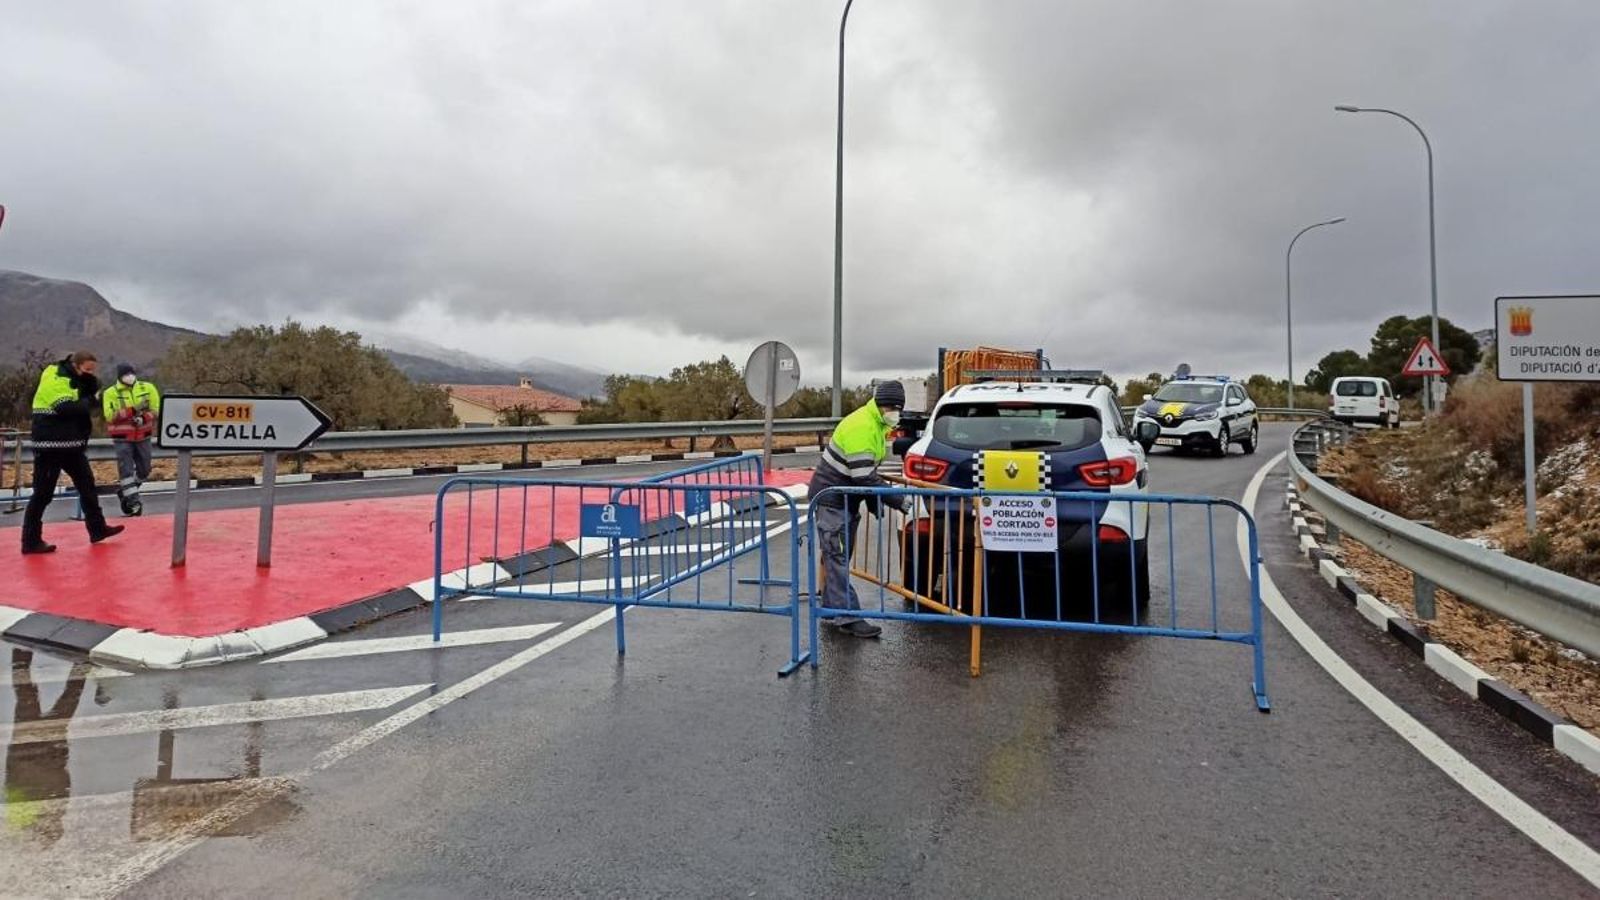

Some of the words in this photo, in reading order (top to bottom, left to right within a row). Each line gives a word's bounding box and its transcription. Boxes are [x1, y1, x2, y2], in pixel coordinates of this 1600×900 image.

[1510, 345, 1581, 357] DIPUTACIÓN
[1520, 361, 1582, 374] DIPUTACIÓ
[196, 406, 250, 418] CV-811
[165, 423, 277, 440] CASTALLA
[999, 500, 1034, 508] ACCESO
[992, 509, 1045, 518] POBLACIÓN
[996, 520, 1041, 529] CORTADO
